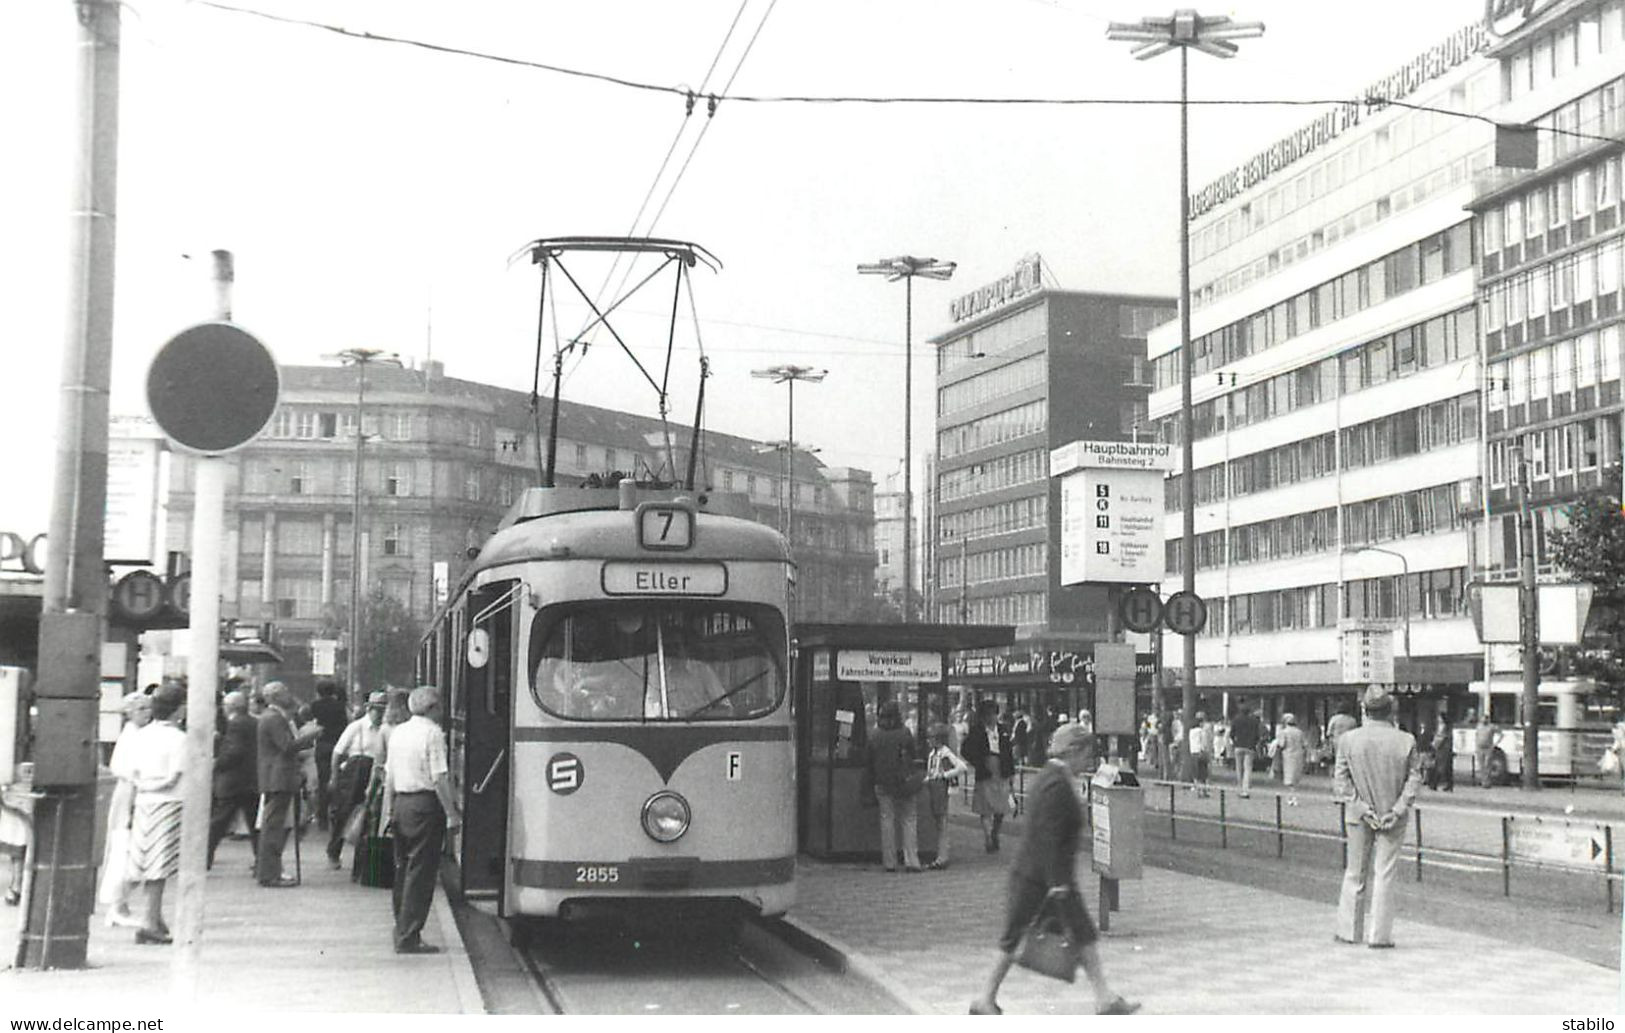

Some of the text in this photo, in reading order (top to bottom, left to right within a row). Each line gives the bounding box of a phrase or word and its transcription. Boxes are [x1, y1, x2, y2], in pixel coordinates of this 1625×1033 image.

[1187, 166, 1241, 221] LGEMEINE
[1083, 443, 1170, 457] Hauptbahnhof
[1098, 455, 1155, 467] Bahnsteig 2
[657, 511, 673, 541] 7
[636, 571, 690, 590] Eller
[128, 581, 149, 608] H
[1132, 600, 1153, 623] H
[1175, 600, 1197, 625] H
[868, 654, 912, 666] Vorverkauf
[841, 666, 938, 678] Fahrscheine Sammelkarten
[730, 754, 741, 779] F
[576, 867, 619, 883] 2855
